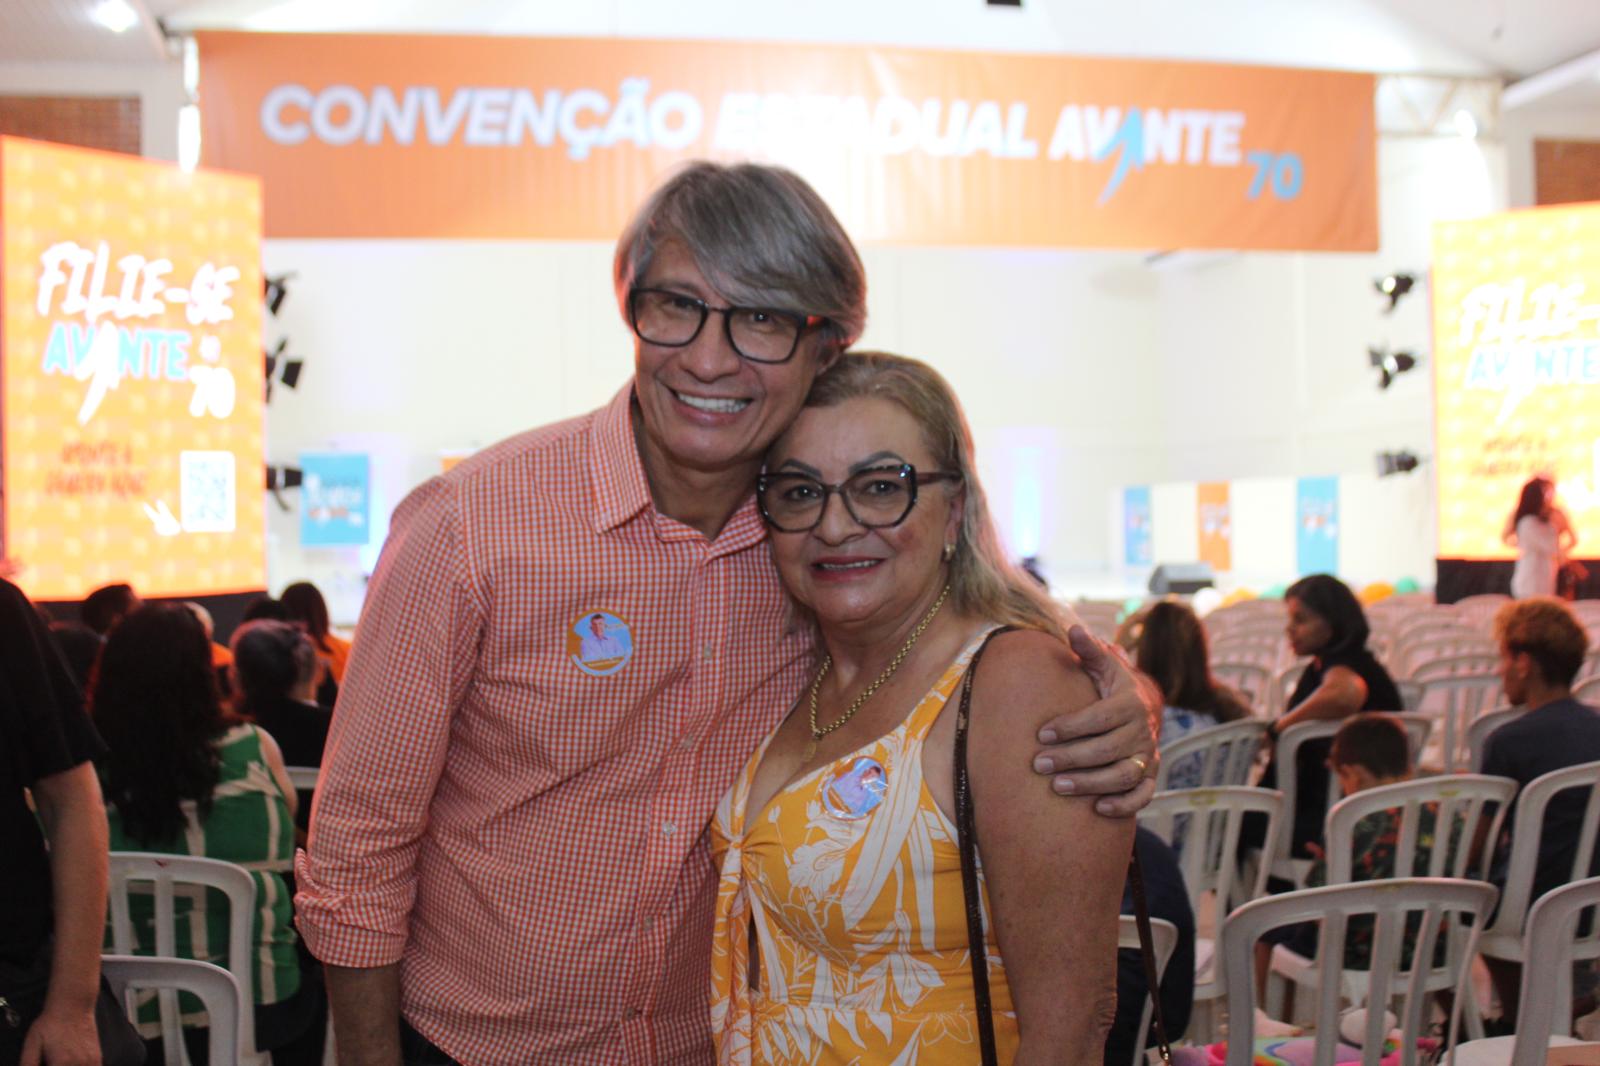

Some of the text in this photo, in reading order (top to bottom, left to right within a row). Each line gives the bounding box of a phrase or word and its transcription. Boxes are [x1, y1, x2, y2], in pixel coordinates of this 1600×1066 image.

[260, 77, 1246, 206] CONVENÇÃO EADUAL AVANTE
[1246, 151, 1305, 201] 70
[1458, 276, 1600, 347] FILIE-
